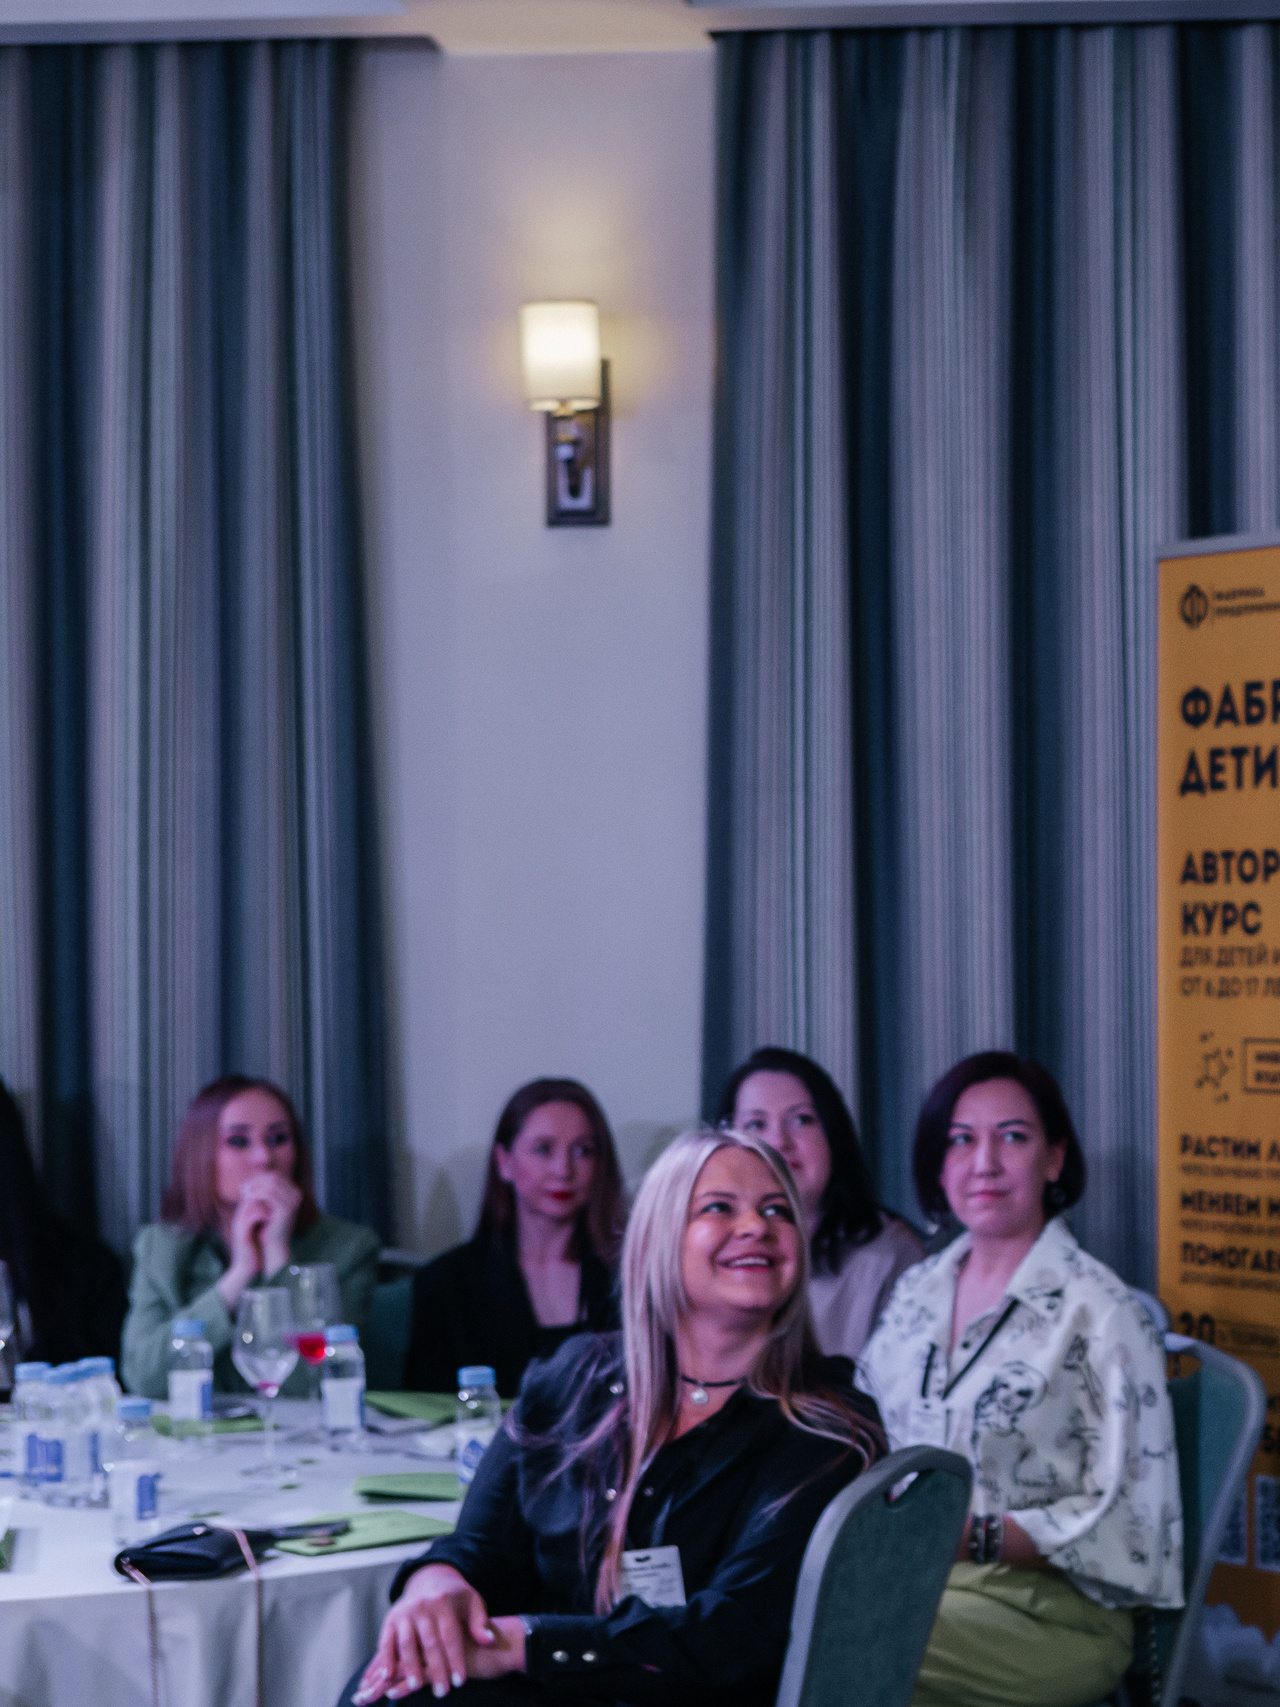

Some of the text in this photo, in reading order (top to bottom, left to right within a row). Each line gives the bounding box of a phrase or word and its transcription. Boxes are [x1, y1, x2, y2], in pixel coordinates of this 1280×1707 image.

[1179, 745, 1280, 797] ДЕТИ
[1181, 901, 1263, 936] КУРС
[1180, 946, 1212, 968] ДЛЯ
[1216, 942, 1268, 968] ДЕТЕЙ
[1181, 976, 1202, 998] ОТ
[1217, 976, 1242, 998] ДО
[1180, 1134, 1261, 1160] РАСТИМ
[1180, 1190, 1261, 1217] МЕНЯЕМ
